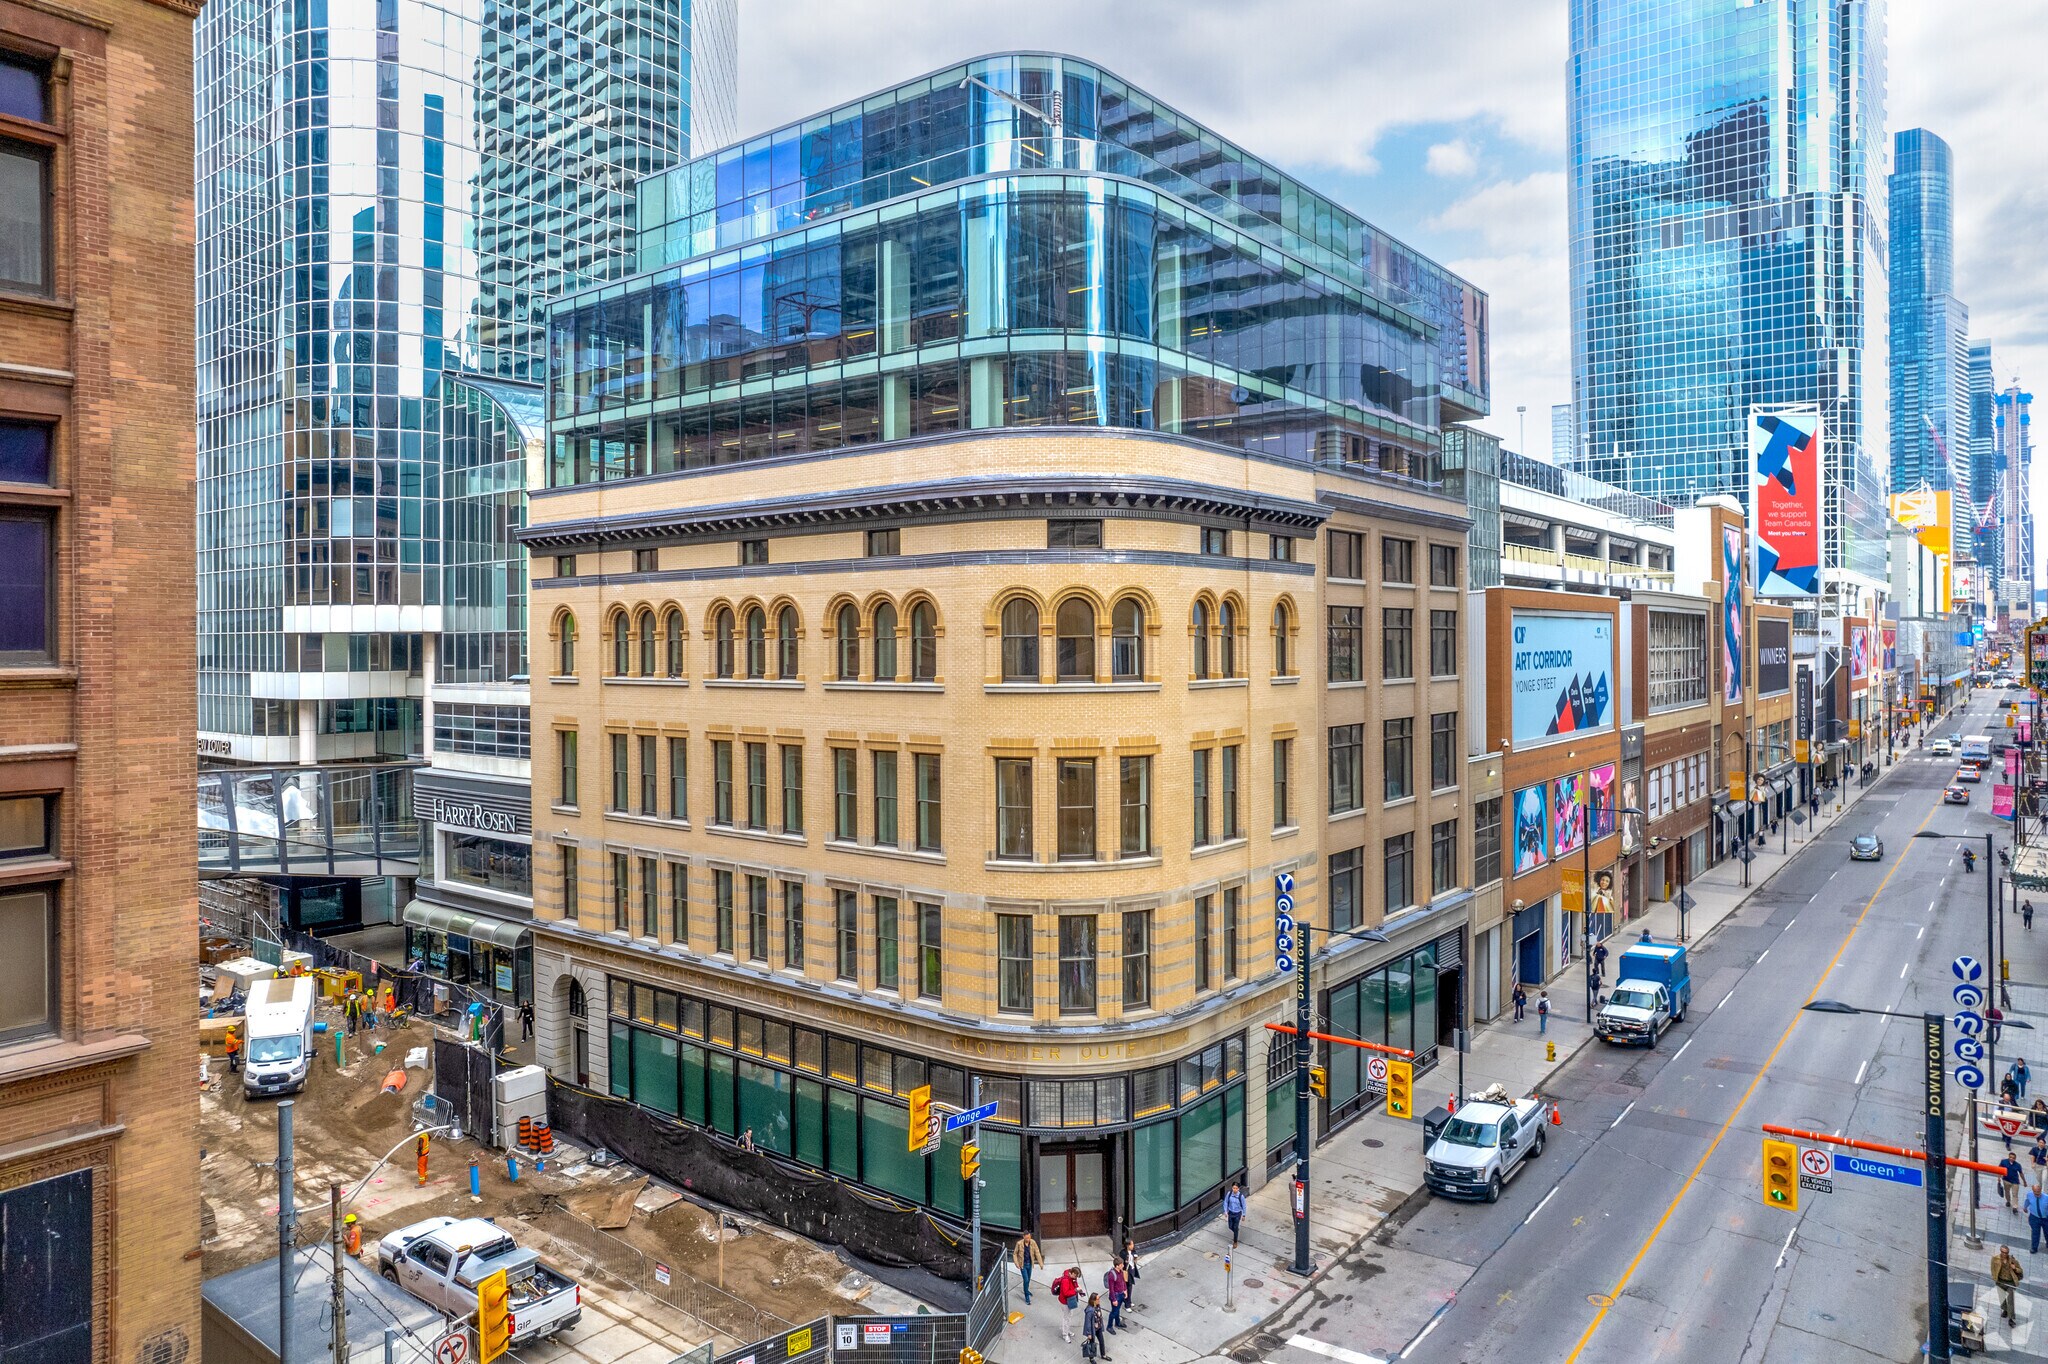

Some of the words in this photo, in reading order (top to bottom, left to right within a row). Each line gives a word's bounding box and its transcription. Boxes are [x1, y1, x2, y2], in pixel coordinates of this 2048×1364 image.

[1772, 501, 1804, 509] Together,
[1515, 626, 1526, 643] CF
[1515, 652, 1531, 671] ART
[1533, 650, 1572, 670] CORRIDOR
[1760, 647, 1787, 665] WINNERS
[1515, 680, 1536, 693] YONGE
[1537, 677, 1557, 692] STREET
[1799, 677, 1807, 739] milestones
[433, 799, 473, 827] HARRY
[474, 804, 516, 833] ROSEN
[1276, 874, 1294, 972] Yonge
[643, 960, 702, 986] CLOTHIER
[827, 1005, 909, 1037] JAMIESON
[952, 1036, 1061, 1062] CLOTHIER
[1952, 955, 1985, 1089] Yonge
[1929, 1023, 1941, 1117] DOWNTOWN
[956, 1110, 980, 1124] Yonge
[1850, 1158, 1894, 1177] Queen
[1801, 1182, 1831, 1192] EXCEPTED
[1811, 1177, 1832, 1187] VEHICLES
[517, 1319, 532, 1331] GIP
[842, 1336, 852, 1344] 10
